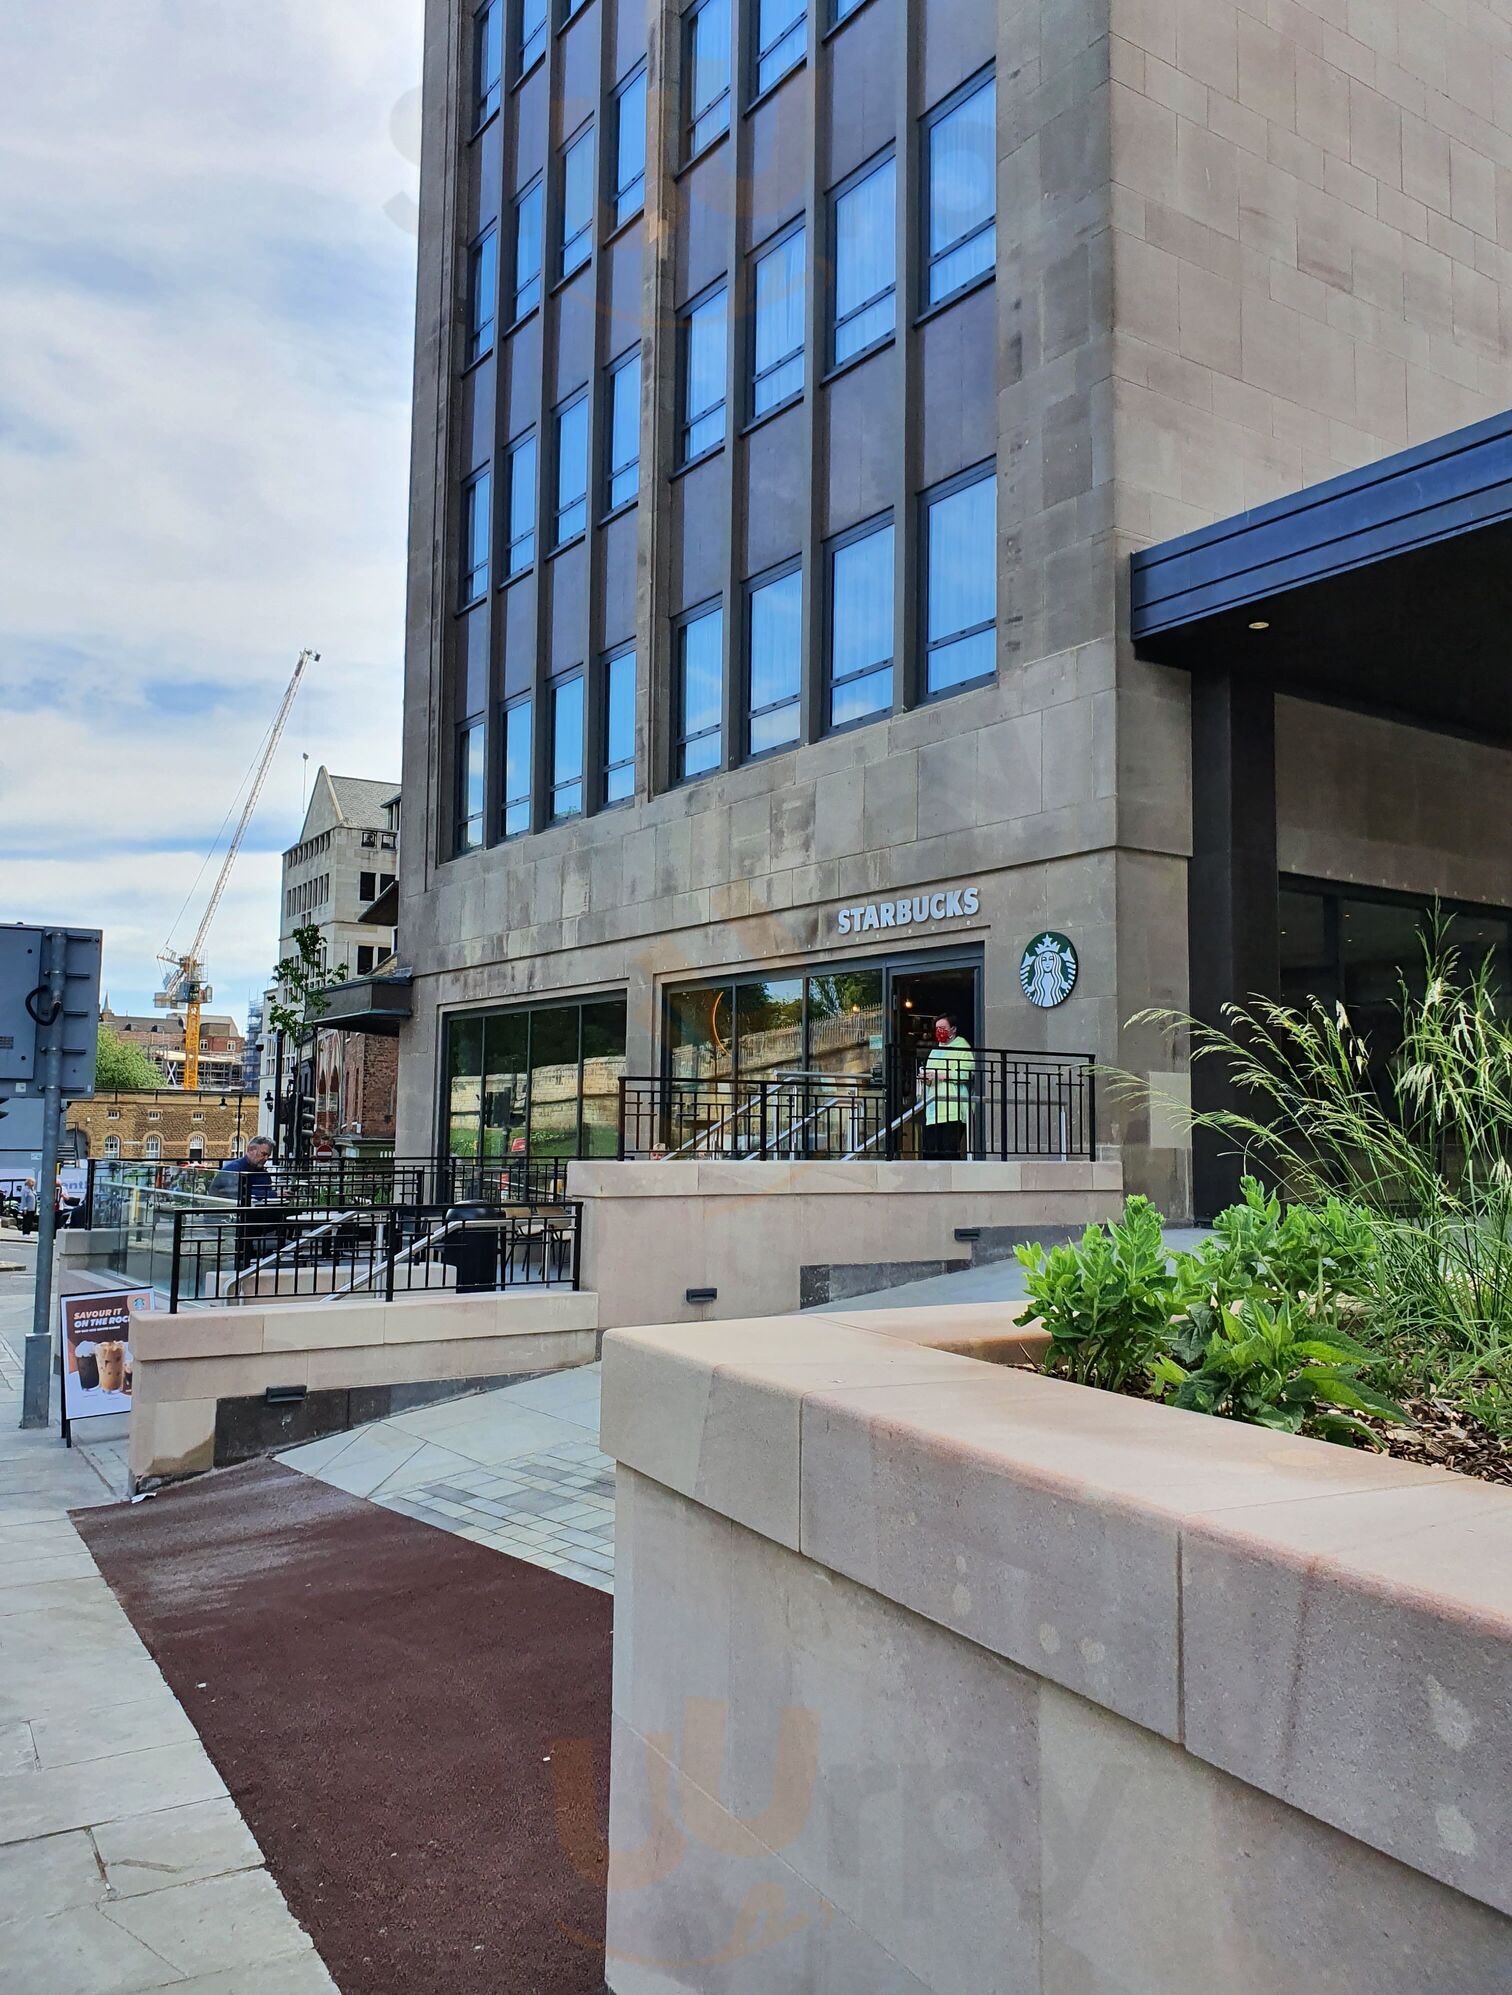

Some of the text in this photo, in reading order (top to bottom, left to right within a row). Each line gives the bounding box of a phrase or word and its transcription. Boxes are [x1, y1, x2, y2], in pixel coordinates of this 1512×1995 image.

[837, 887, 980, 935] STARBUCKS
[74, 1308, 122, 1320] SAVOUR IT
[74, 1315, 129, 1328] ON THE ROC
